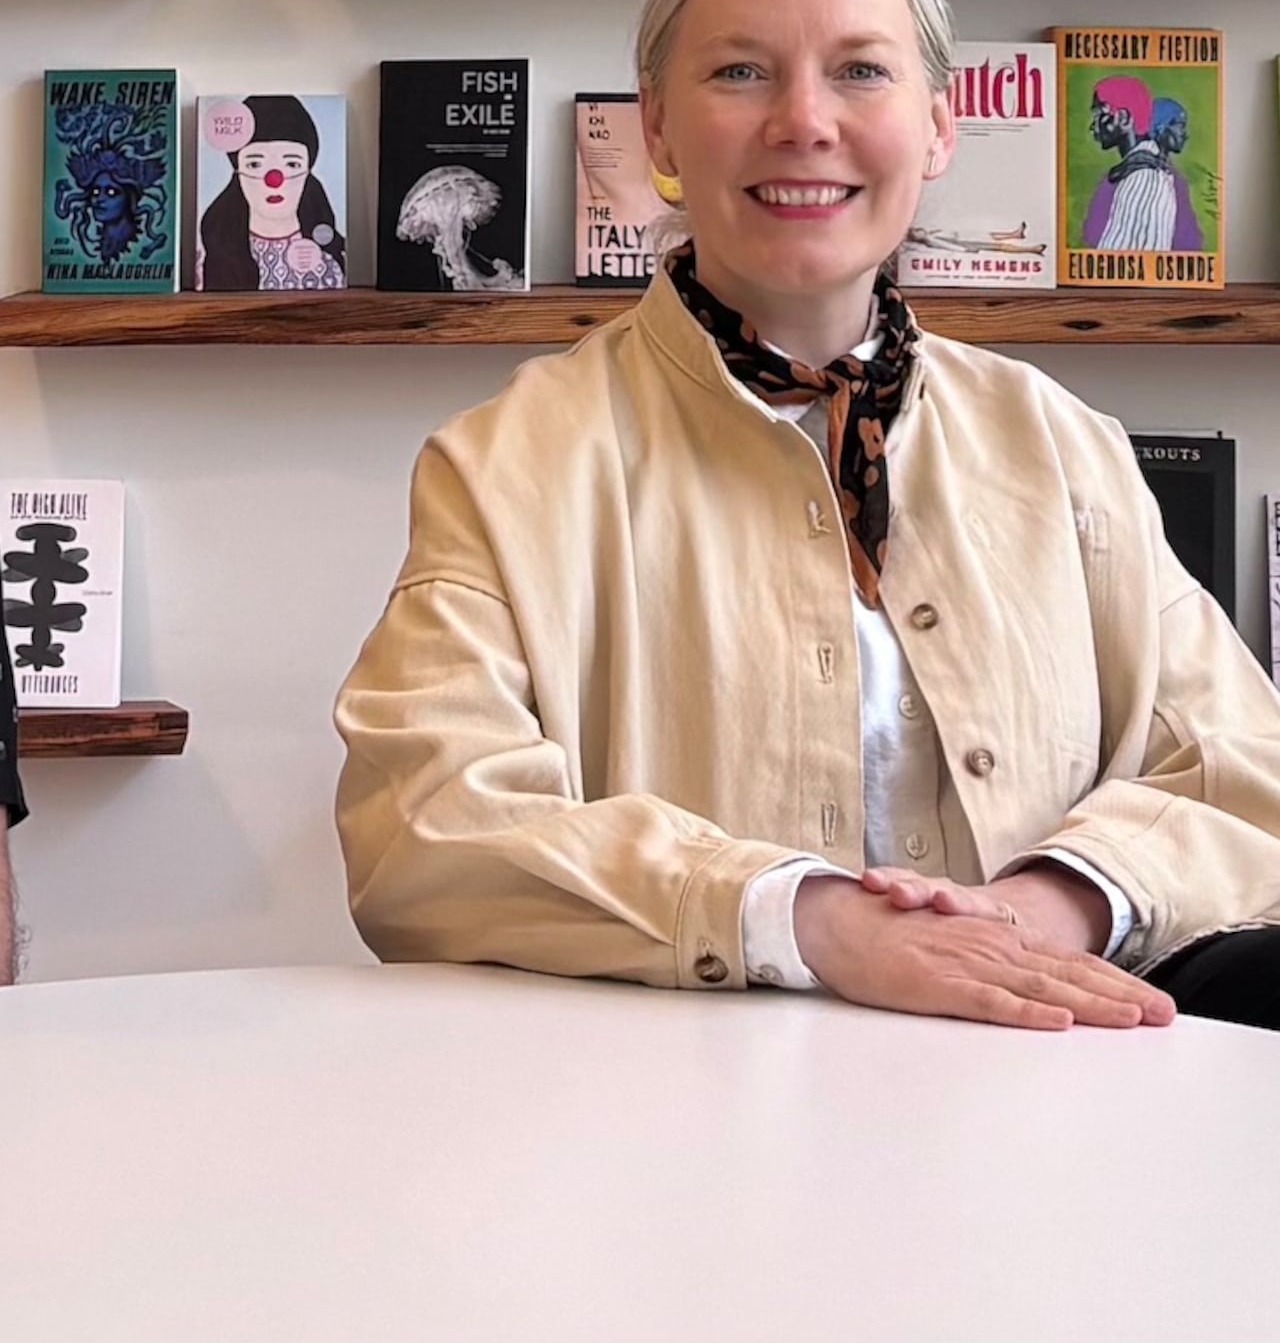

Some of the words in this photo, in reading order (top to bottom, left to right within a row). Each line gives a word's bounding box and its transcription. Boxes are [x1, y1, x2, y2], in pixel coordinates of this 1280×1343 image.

[1064, 33, 1149, 60] NECESSARY
[1159, 35, 1219, 62] FICTION
[115, 82, 176, 105] SIREN
[462, 72, 518, 94] FISH
[214, 116, 243, 126] WILD
[445, 104, 516, 126] EXILE
[214, 127, 243, 136] MILK
[586, 207, 612, 221] THE
[588, 225, 647, 249] ITALY
[911, 258, 962, 272] EMILY
[971, 259, 1043, 274] NEMENS
[1069, 252, 1145, 282] ELOGHOSA
[1156, 255, 1215, 283] OSUNDE
